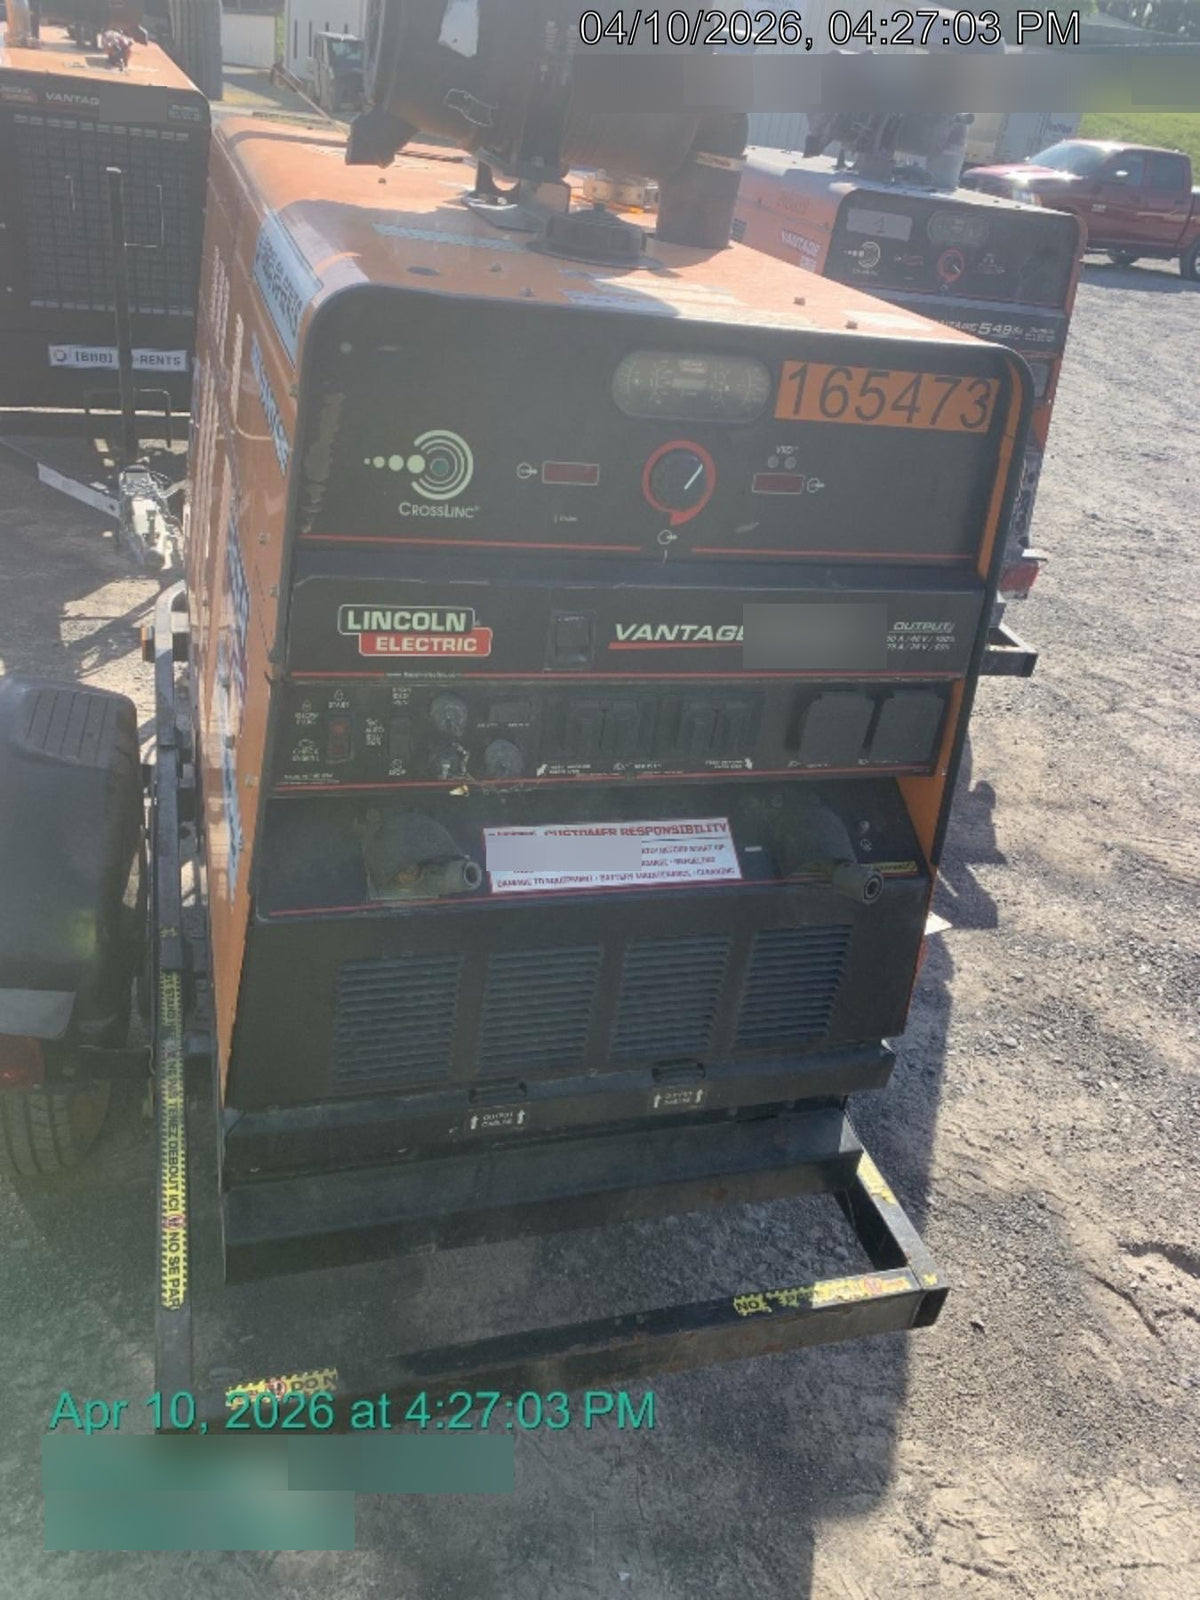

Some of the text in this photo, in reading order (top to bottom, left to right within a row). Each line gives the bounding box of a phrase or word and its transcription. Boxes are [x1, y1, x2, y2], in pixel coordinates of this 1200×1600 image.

[45, 91, 101, 106] VANTAG
[787, 363, 991, 430] 165473
[347, 610, 467, 632] LINCOLN
[375, 636, 477, 652] ELECTRIC
[620, 823, 727, 836] RESPONSIBILITY
[168, 1140, 179, 1191] DEBOUT
[168, 1194, 180, 1212] ICI
[168, 1231, 181, 1253] NO
[168, 1256, 181, 1275] SE
[736, 1297, 760, 1311] NO
